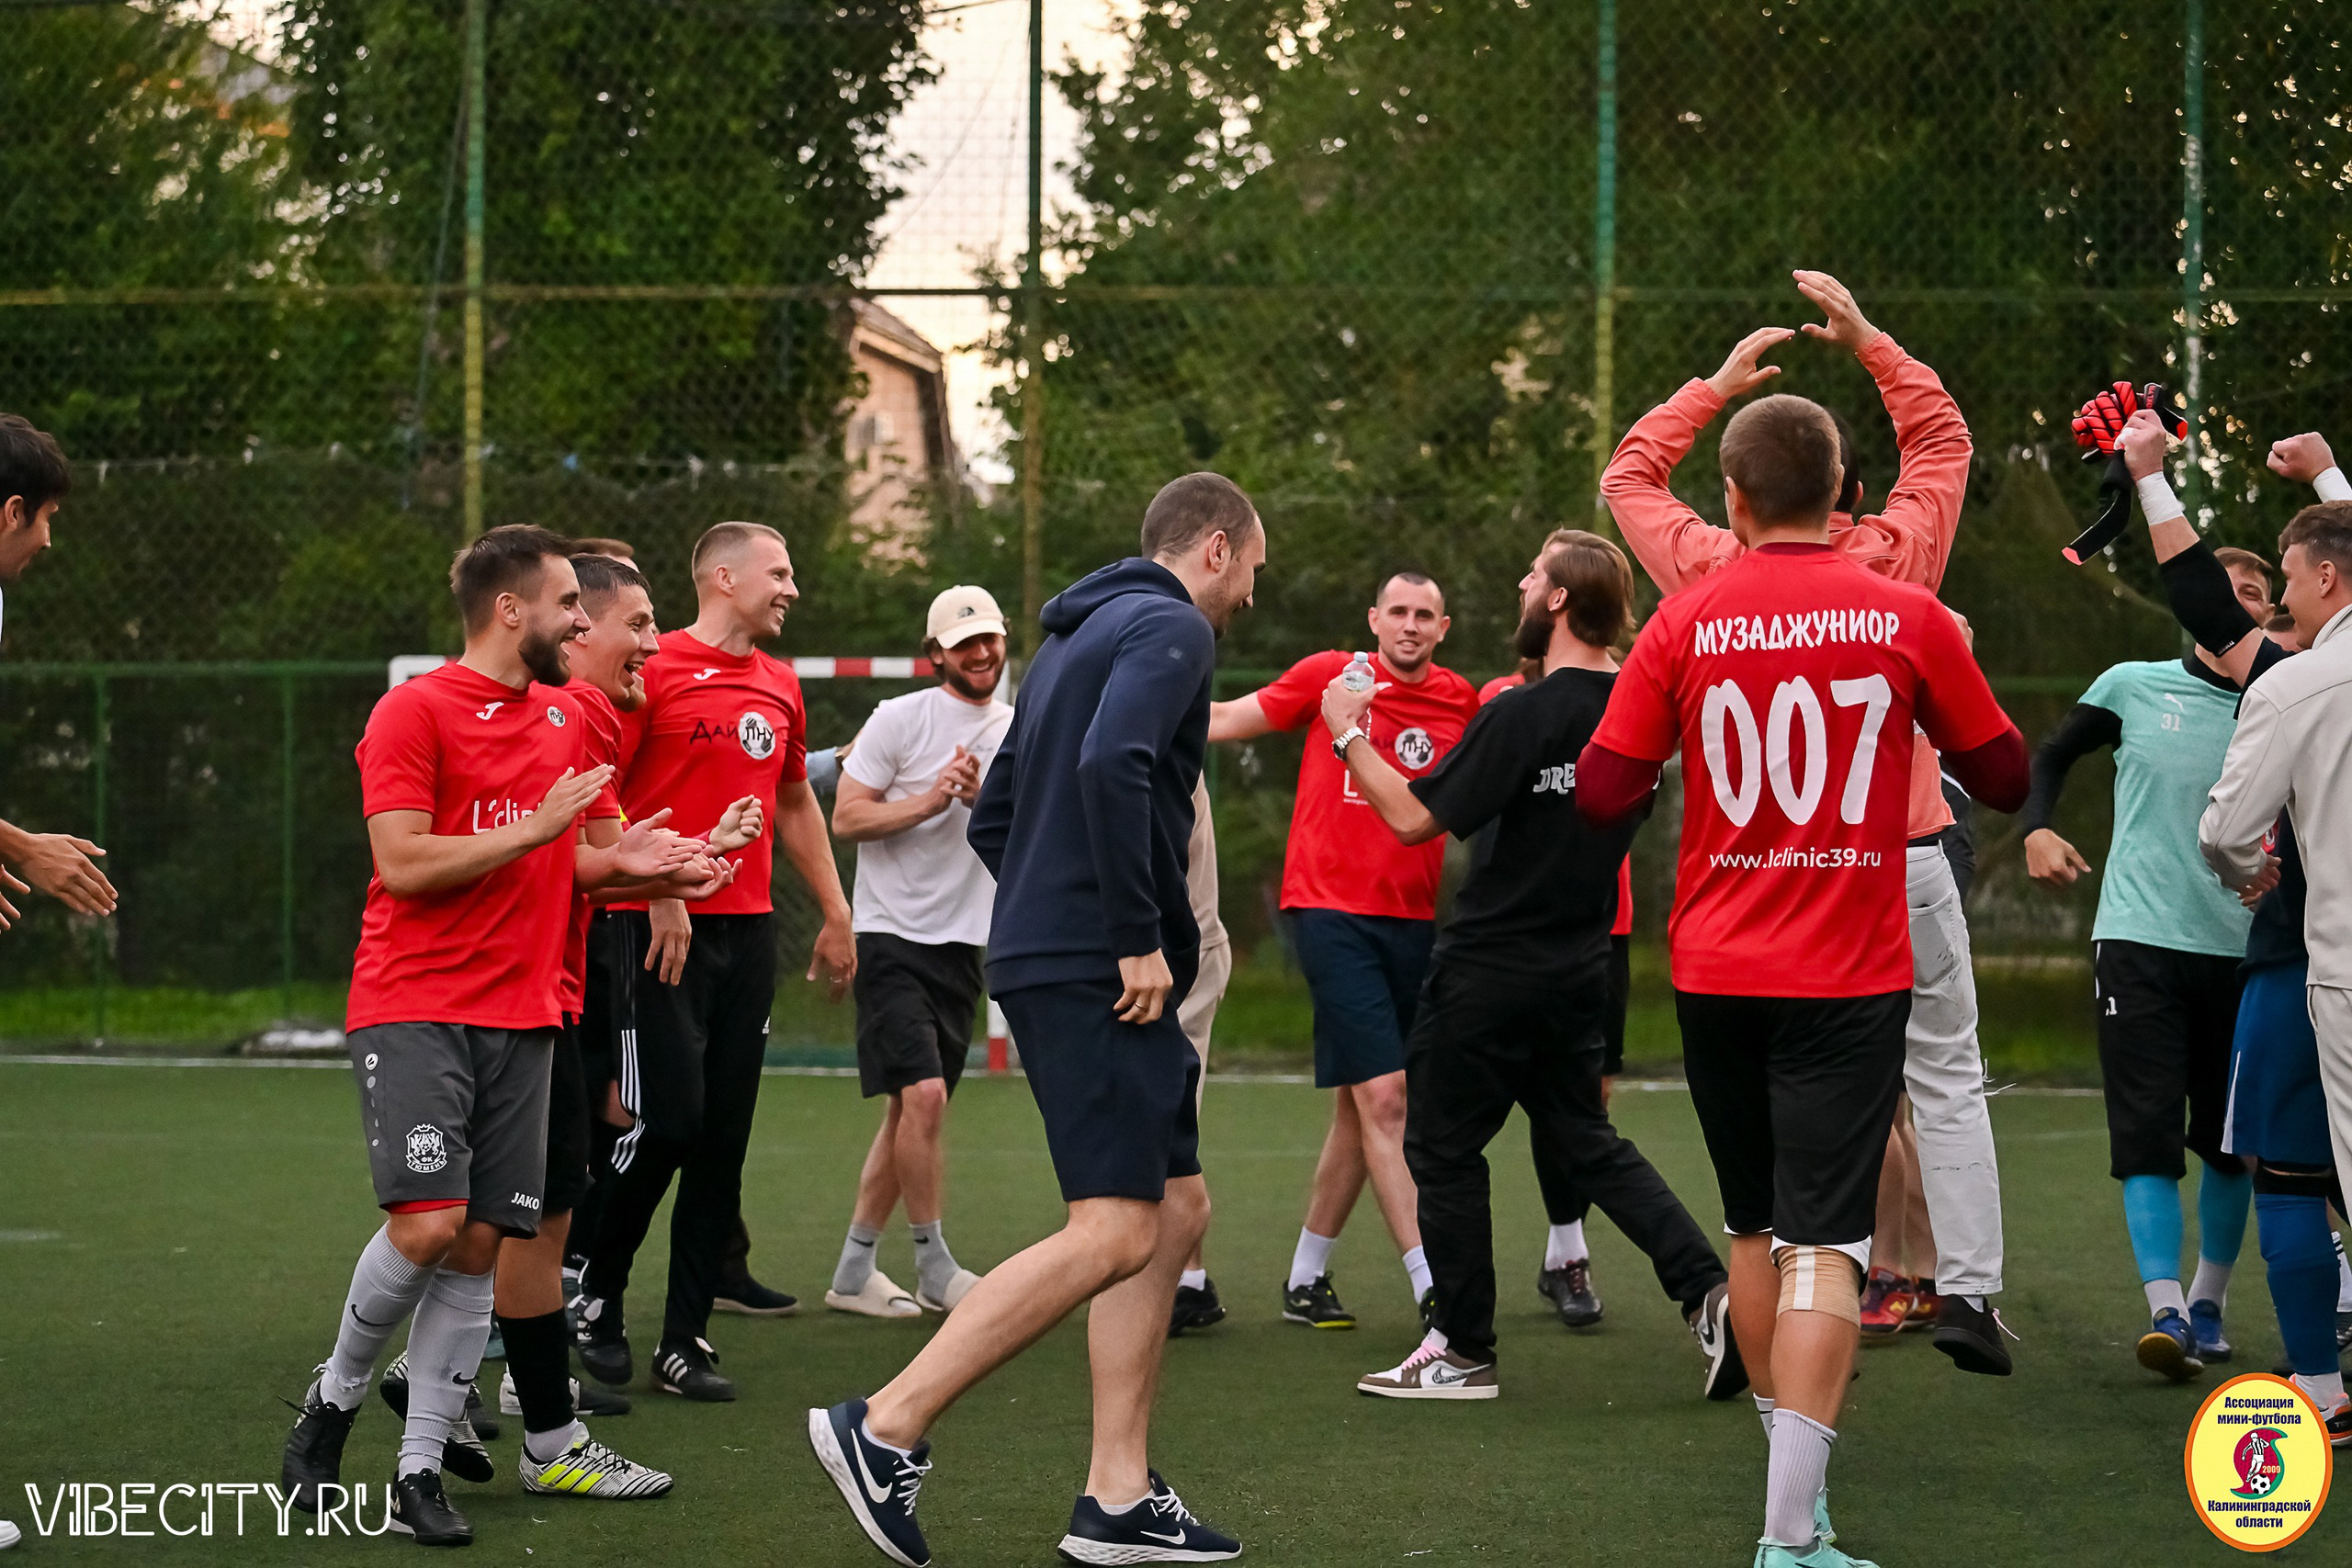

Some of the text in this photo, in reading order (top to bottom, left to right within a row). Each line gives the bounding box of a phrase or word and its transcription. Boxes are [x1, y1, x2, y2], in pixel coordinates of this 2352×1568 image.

[1695, 608, 1900, 658] МУЗАДЖУНИОР
[2160, 712, 2180, 732] 31
[1702, 672, 1892, 827] 007
[1532, 762, 1577, 795] DRE
[2105, 996, 2118, 1016] 1
[410, 1159, 445, 1171] ТЮМЕНЬ
[511, 1192, 540, 1211] JAKO
